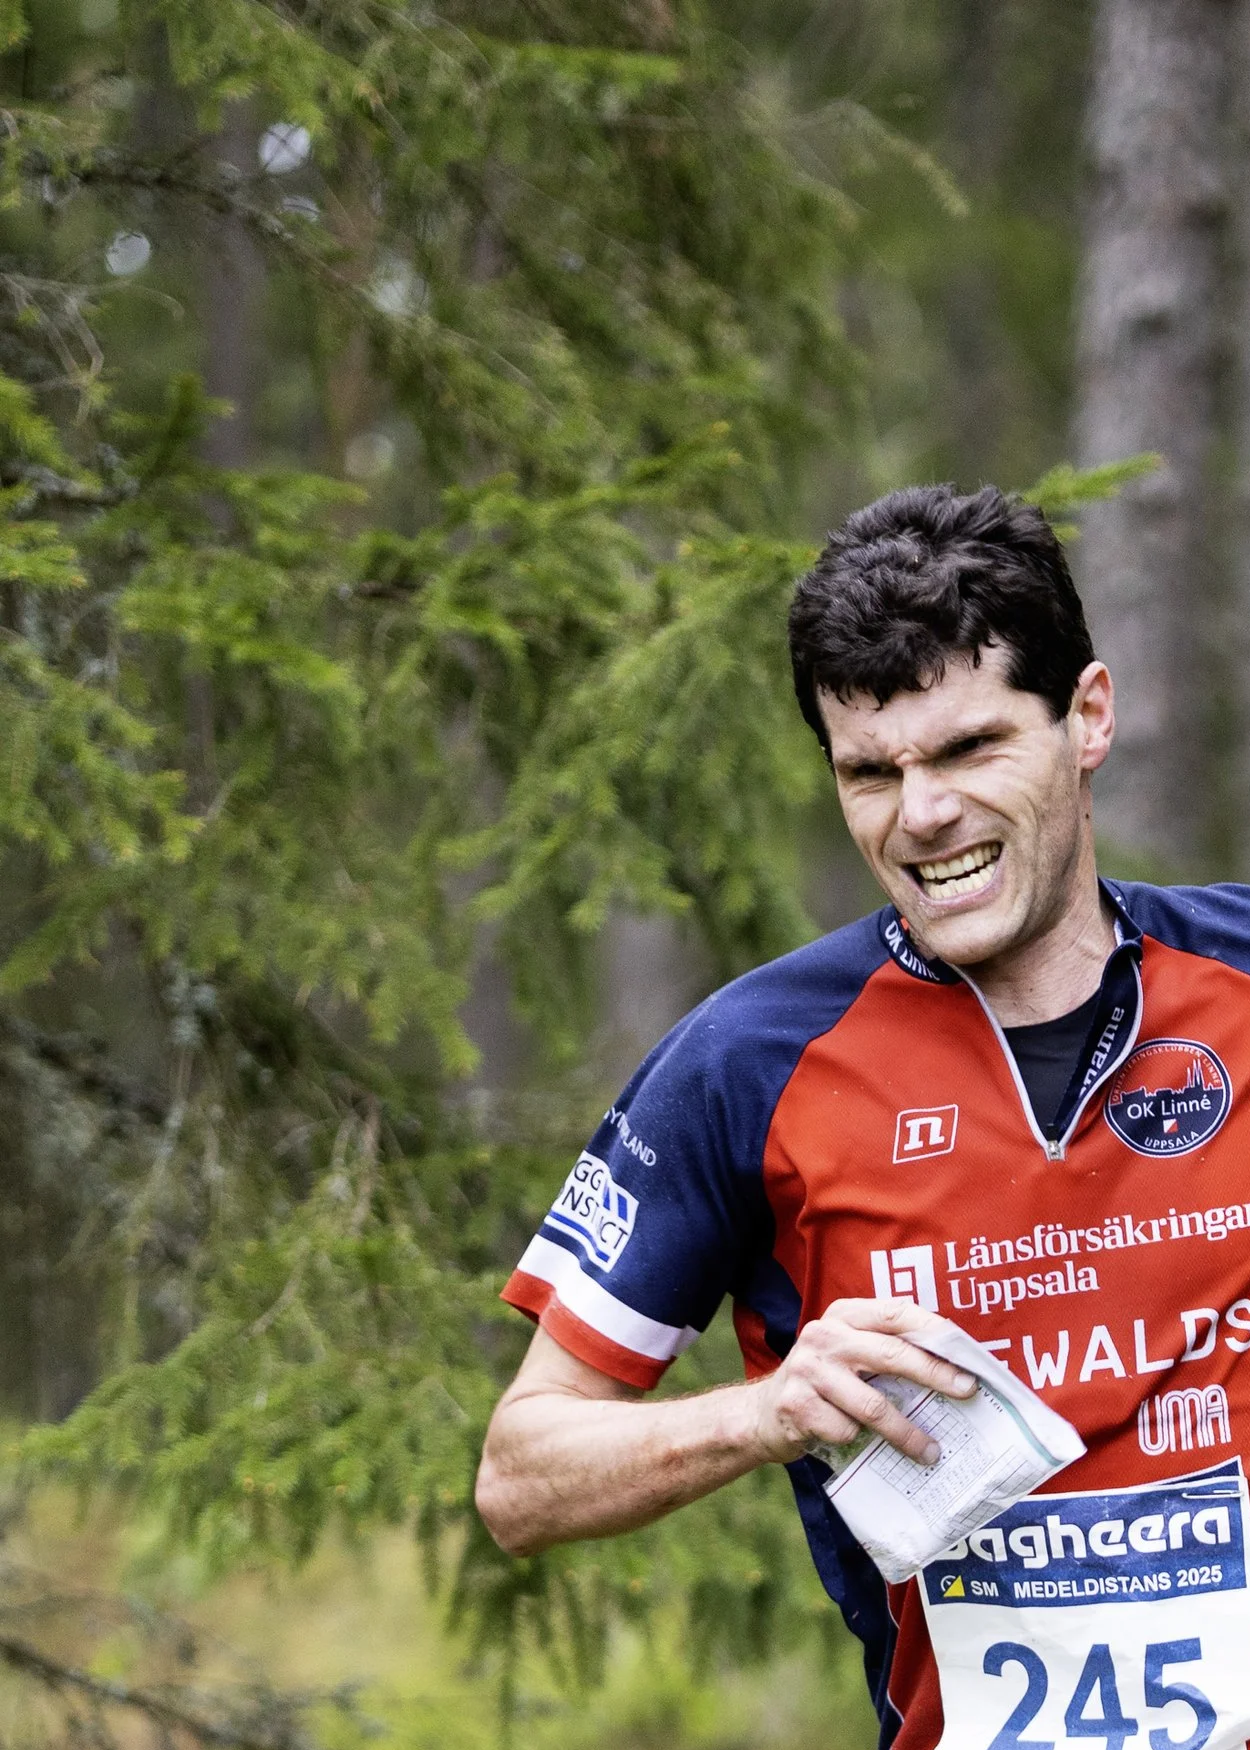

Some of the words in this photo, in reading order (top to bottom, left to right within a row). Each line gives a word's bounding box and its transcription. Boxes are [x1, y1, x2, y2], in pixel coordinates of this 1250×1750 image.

[1126, 1102, 1156, 1120] OK
[1161, 1094, 1212, 1117] Linné
[1144, 1130, 1201, 1150] UPPSALA
[947, 1260, 1101, 1315] Uppsala
[1138, 1384, 1232, 1456] UMA
[970, 1580, 999, 1598] SM
[1013, 1572, 1171, 1600] MEDELDISTANS
[1176, 1564, 1223, 1589] 2025
